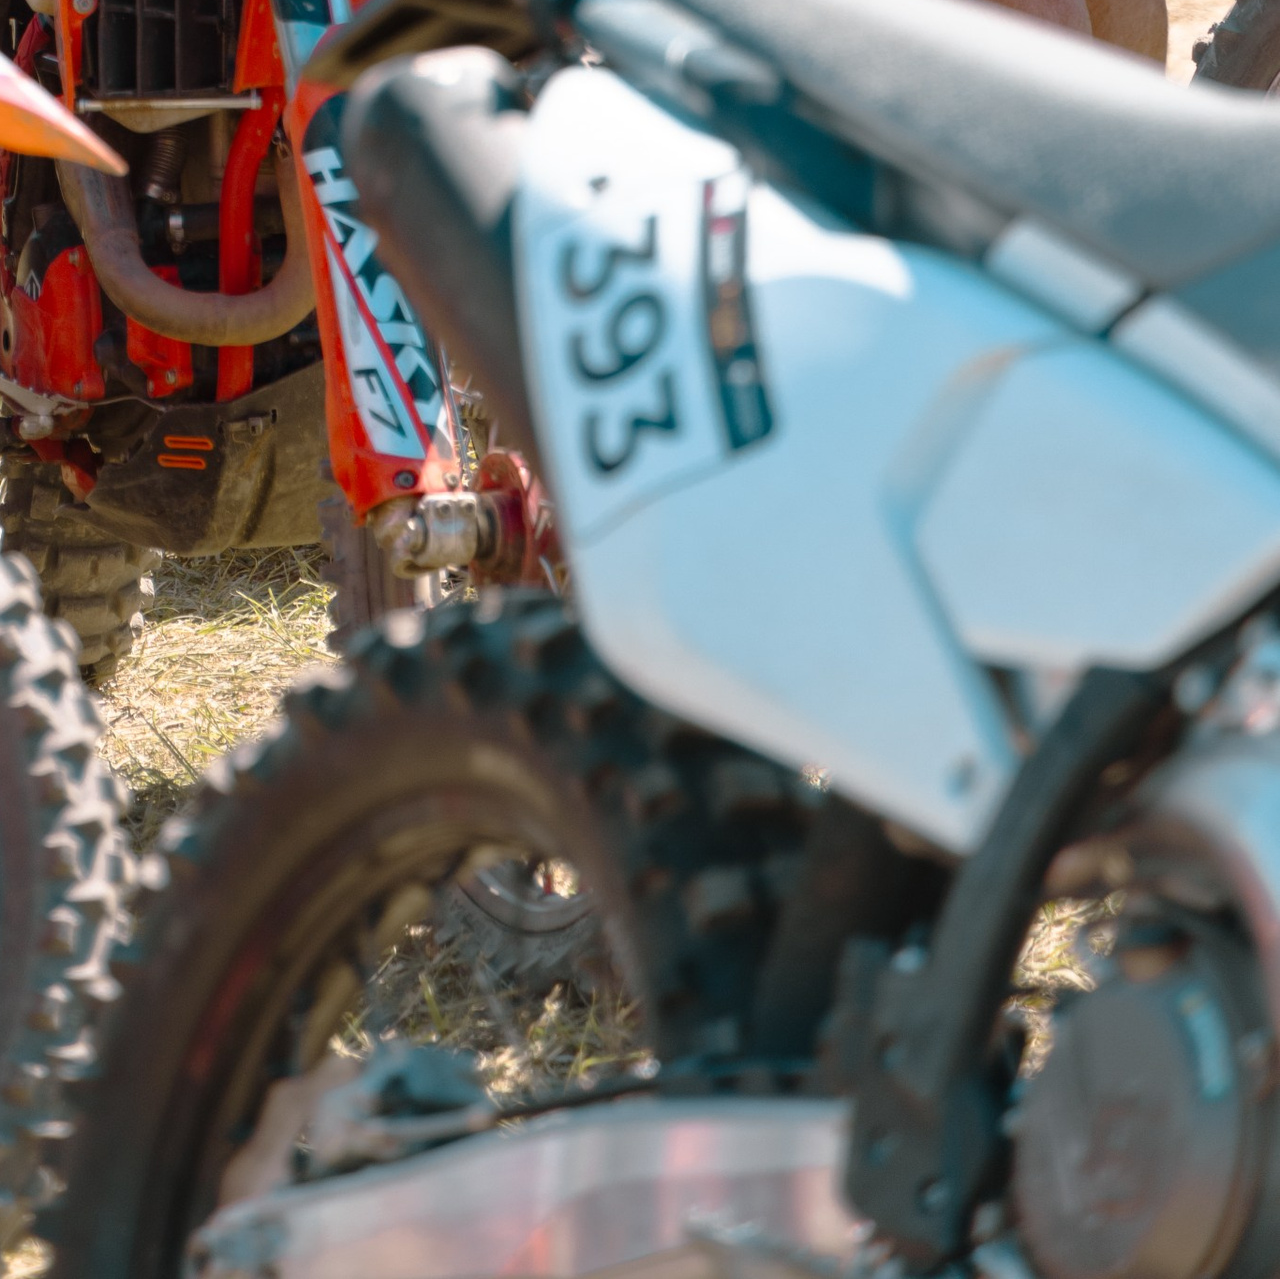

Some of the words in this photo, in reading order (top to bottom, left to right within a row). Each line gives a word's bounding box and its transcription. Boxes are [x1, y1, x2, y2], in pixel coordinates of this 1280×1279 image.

[302, 145, 445, 427] HASKY
[353, 367, 408, 439] F7
[560, 214, 678, 473] 393
